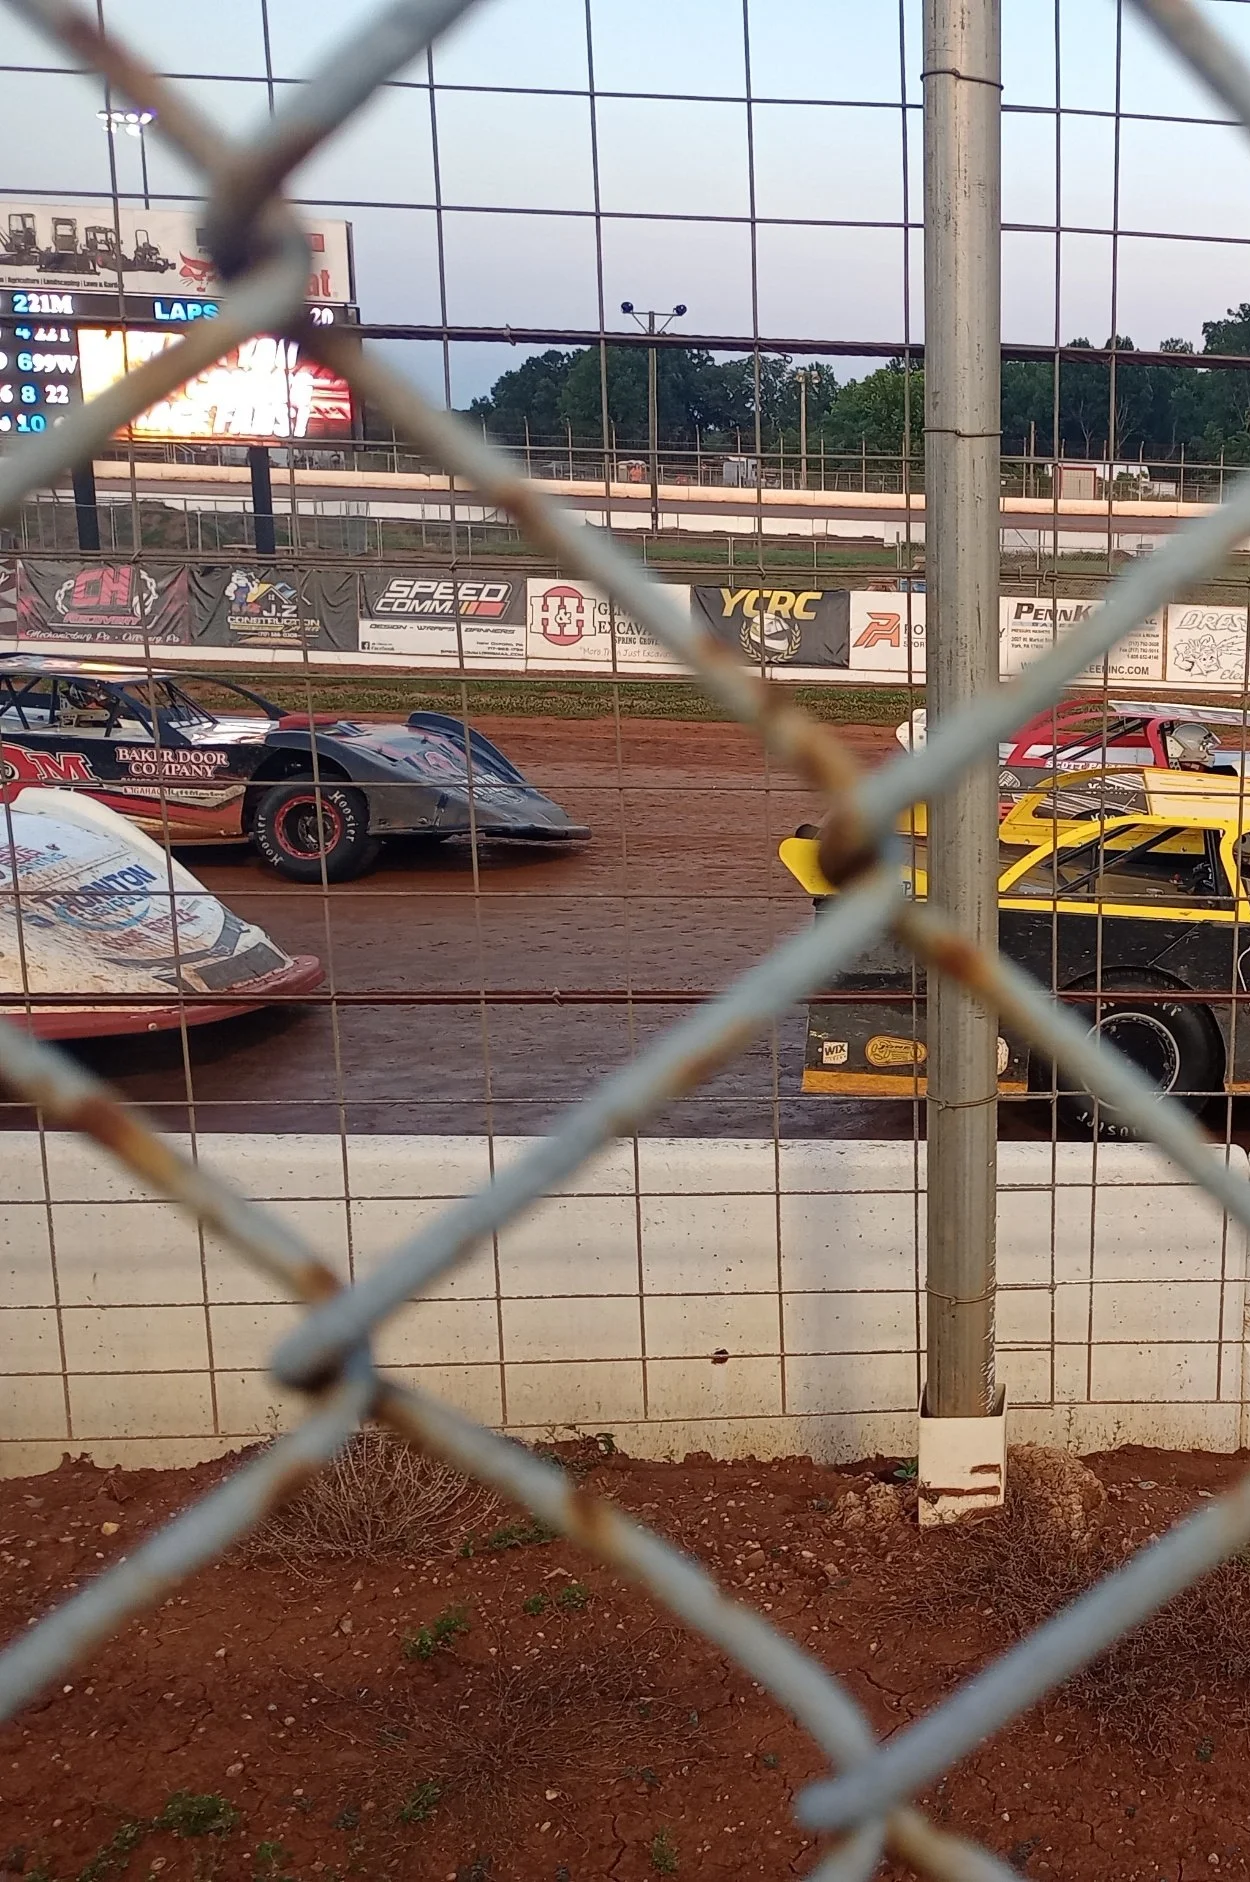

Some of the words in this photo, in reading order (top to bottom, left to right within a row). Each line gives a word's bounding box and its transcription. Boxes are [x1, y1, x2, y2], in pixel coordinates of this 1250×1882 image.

[154, 302, 219, 321] LAPS
[21, 386, 36, 403] 8
[45, 385, 69, 403] 22
[17, 414, 46, 432] 10
[385, 580, 508, 601] SPEED
[720, 588, 822, 620] YCRC
[227, 615, 320, 627] CONSTRUCTON
[180, 751, 228, 765] DOOR
[1046, 760, 1085, 770] SCOTT
[131, 761, 215, 777] COMPANY
[328, 790, 359, 842] Hoosier
[824, 1044, 846, 1056] WIX
